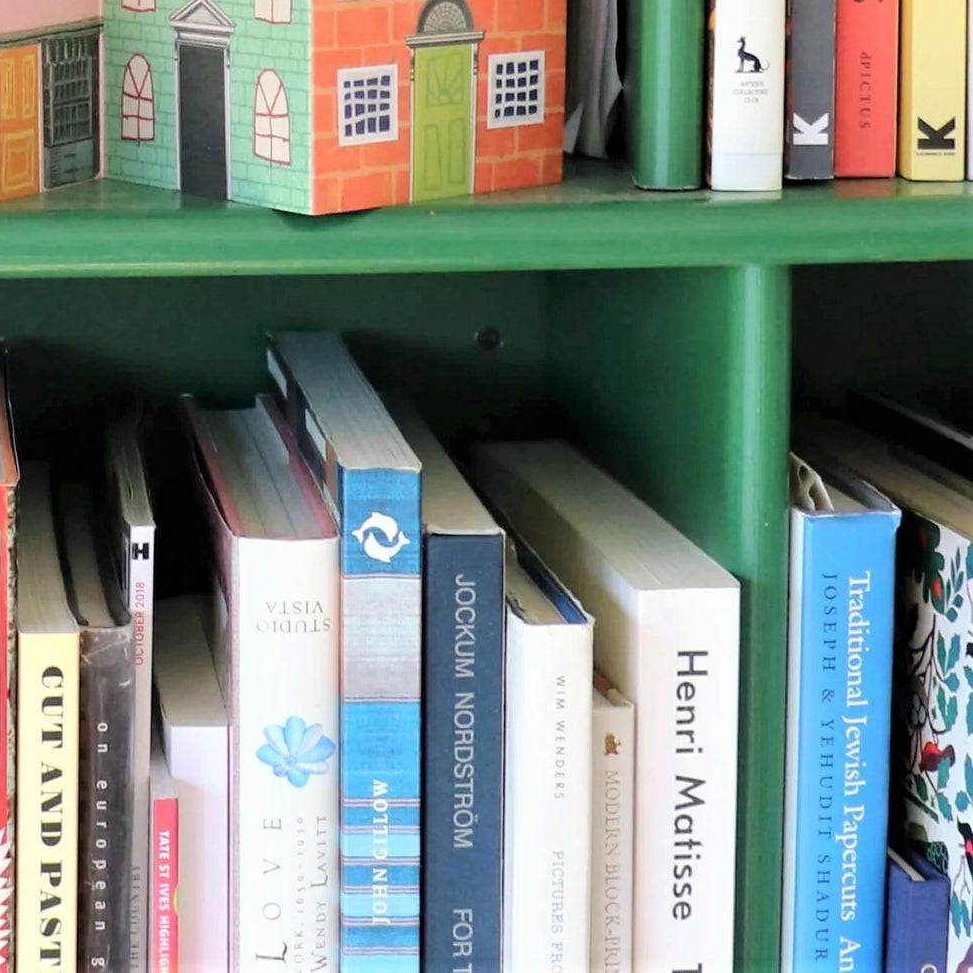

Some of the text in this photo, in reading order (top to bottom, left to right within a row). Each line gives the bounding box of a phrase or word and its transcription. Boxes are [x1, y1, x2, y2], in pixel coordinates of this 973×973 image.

[131, 542, 150, 561] H
[132, 581, 147, 666] OCTOBER 2018
[256, 618, 332, 634] STUDIO
[266, 601, 324, 615] VISTA
[454, 573, 477, 678] JOCKUM
[846, 570, 872, 708] Traditional
[40, 665, 65, 749] CUT
[554, 675, 566, 710] WIM
[676, 650, 709, 755] Henri
[96, 721, 110, 754] on
[452, 691, 479, 848] NORDSTRÖM
[554, 720, 566, 800] WENDERS
[814, 573, 839, 962] JOSEPH & YEHUDIT SHADUR
[841, 713, 869, 797] Jewish
[40, 761, 64, 847] AND
[158, 830, 171, 860] TATE
[605, 769, 622, 856] MODERN
[92, 779, 110, 931] european
[158, 864, 171, 878] ST
[372, 779, 391, 925] JOHN GILLOW
[672, 774, 707, 922] Matisse
[834, 804, 867, 922] Papercuts
[158, 882, 171, 910] IVES
[255, 818, 288, 965] LOVE
[309, 813, 329, 973] WENDY LAVITT
[451, 907, 474, 956] FOR
[552, 850, 565, 933] PICTURES
